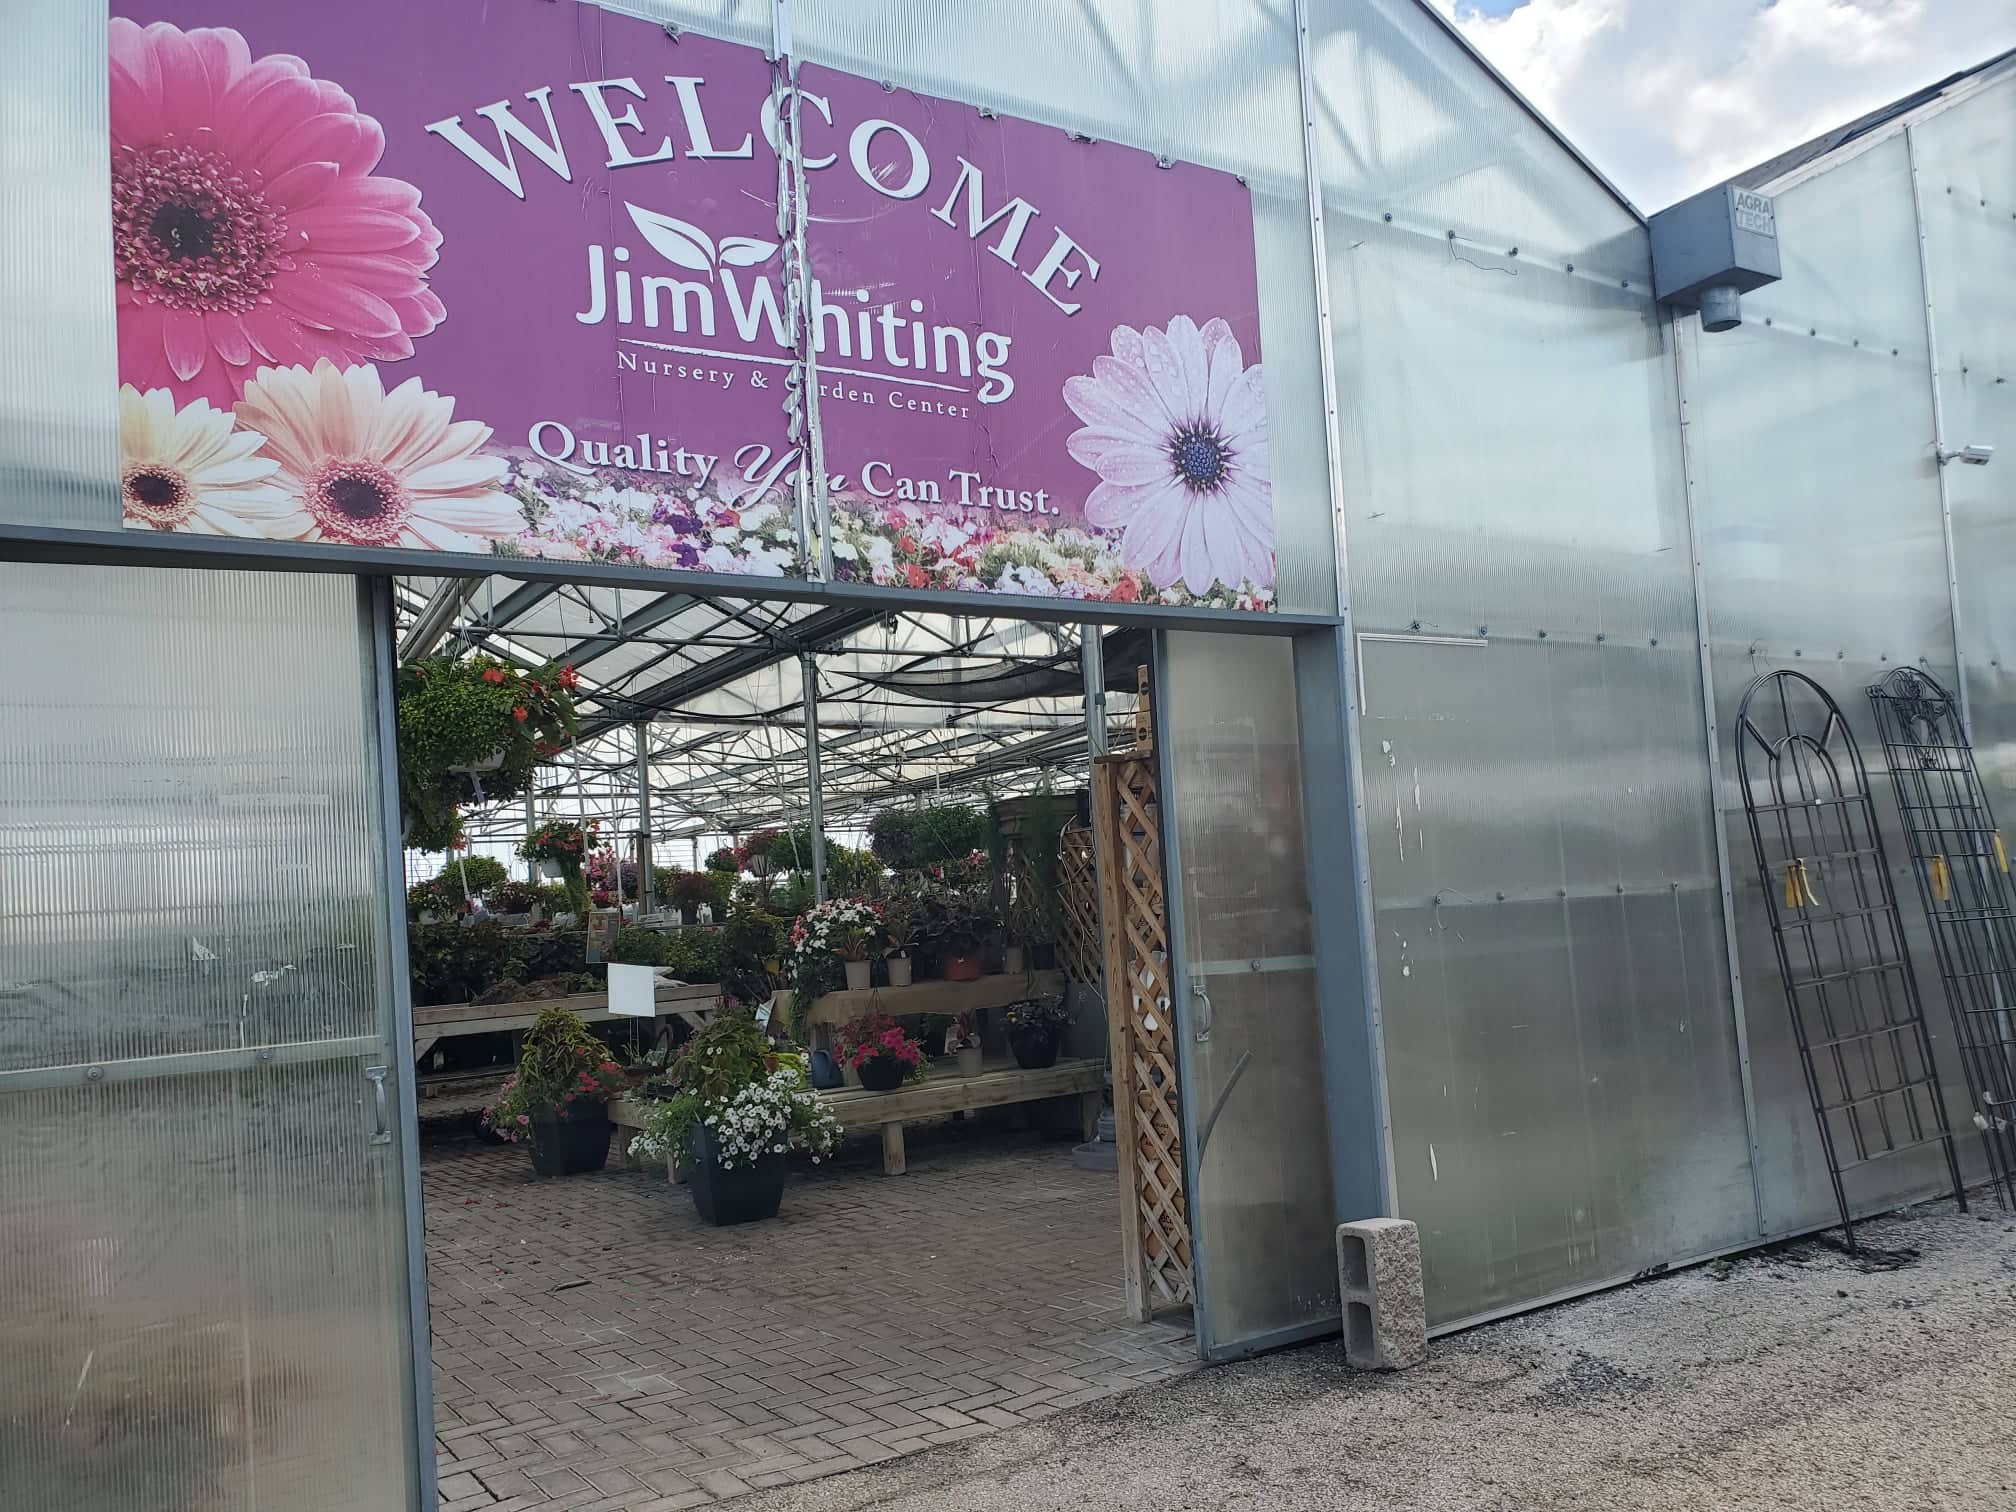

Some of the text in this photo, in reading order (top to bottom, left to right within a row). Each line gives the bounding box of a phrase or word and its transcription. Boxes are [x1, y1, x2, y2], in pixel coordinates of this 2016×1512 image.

[424, 75, 1101, 316] WELCOME
[1737, 194, 1769, 213] AGRA
[1739, 213, 1772, 233] TECH
[616, 350, 734, 389] Nursery
[750, 370, 769, 389] &
[888, 391, 969, 418] Center
[528, 421, 718, 489] Quality
[861, 461, 942, 503] Can
[949, 469, 1060, 515] Trust.
